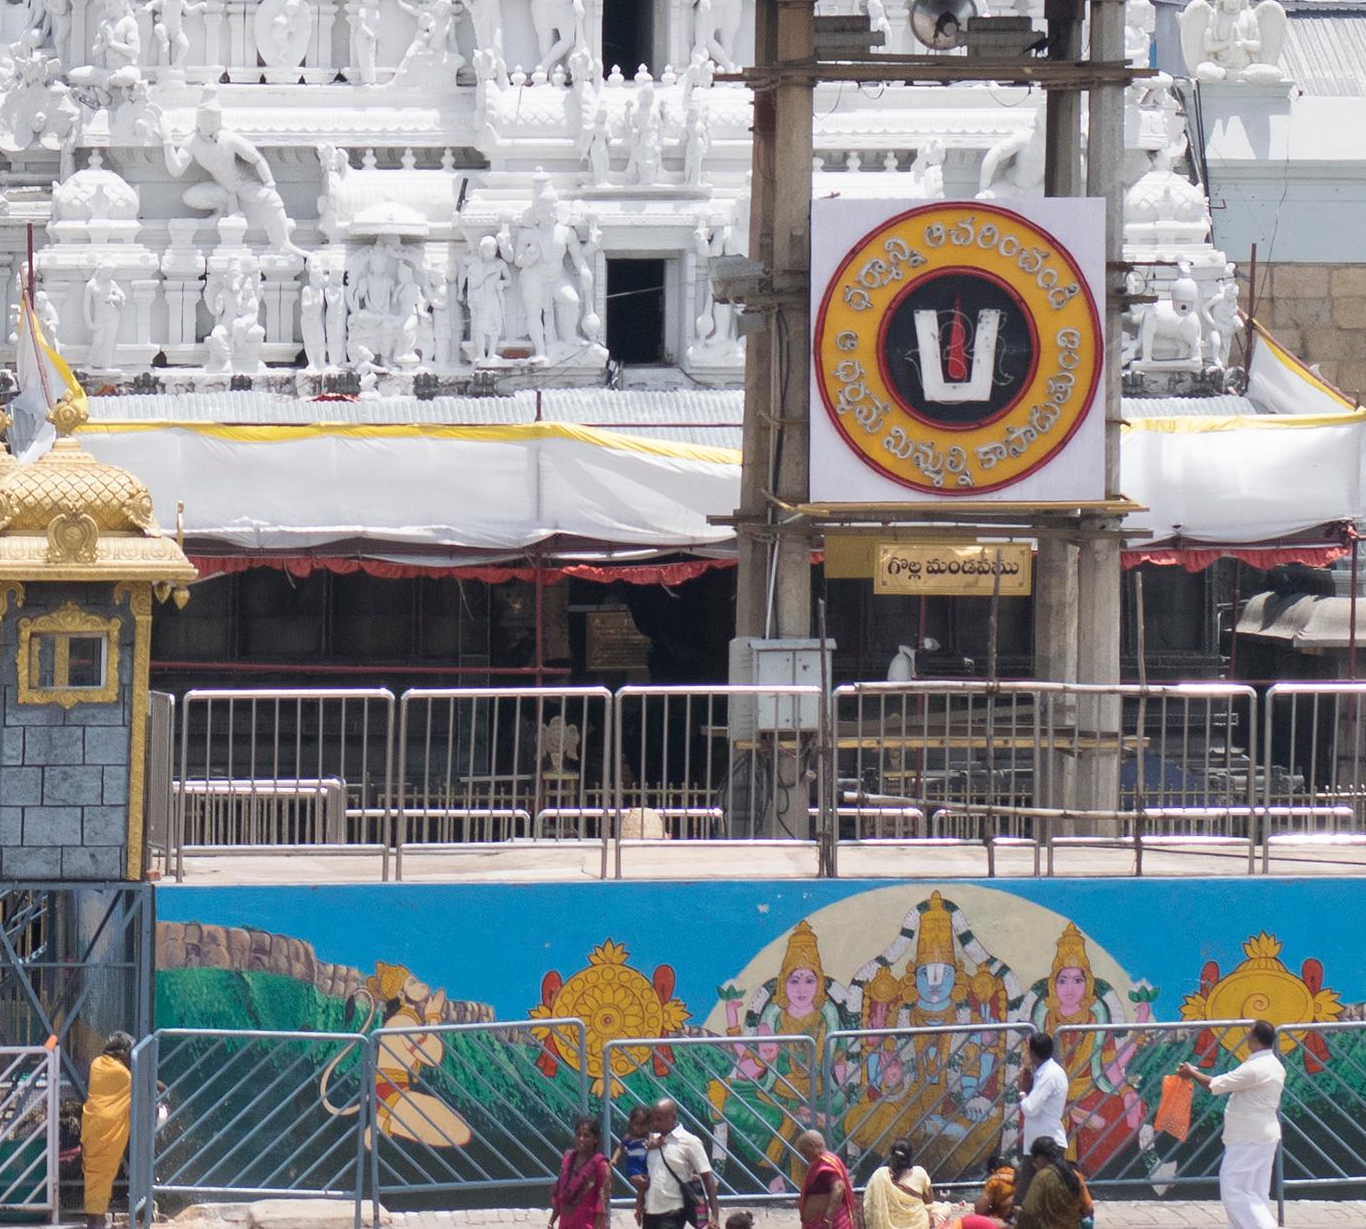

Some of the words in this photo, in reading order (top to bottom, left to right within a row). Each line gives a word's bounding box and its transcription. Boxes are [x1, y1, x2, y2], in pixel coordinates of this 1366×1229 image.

[843, 236, 928, 311] ధర్మాన్ని
[923, 217, 1079, 309] ఆచరించండి
[977, 328, 1081, 468] కాపాడుతుంది
[887, 556, 922, 580] గొల్ల
